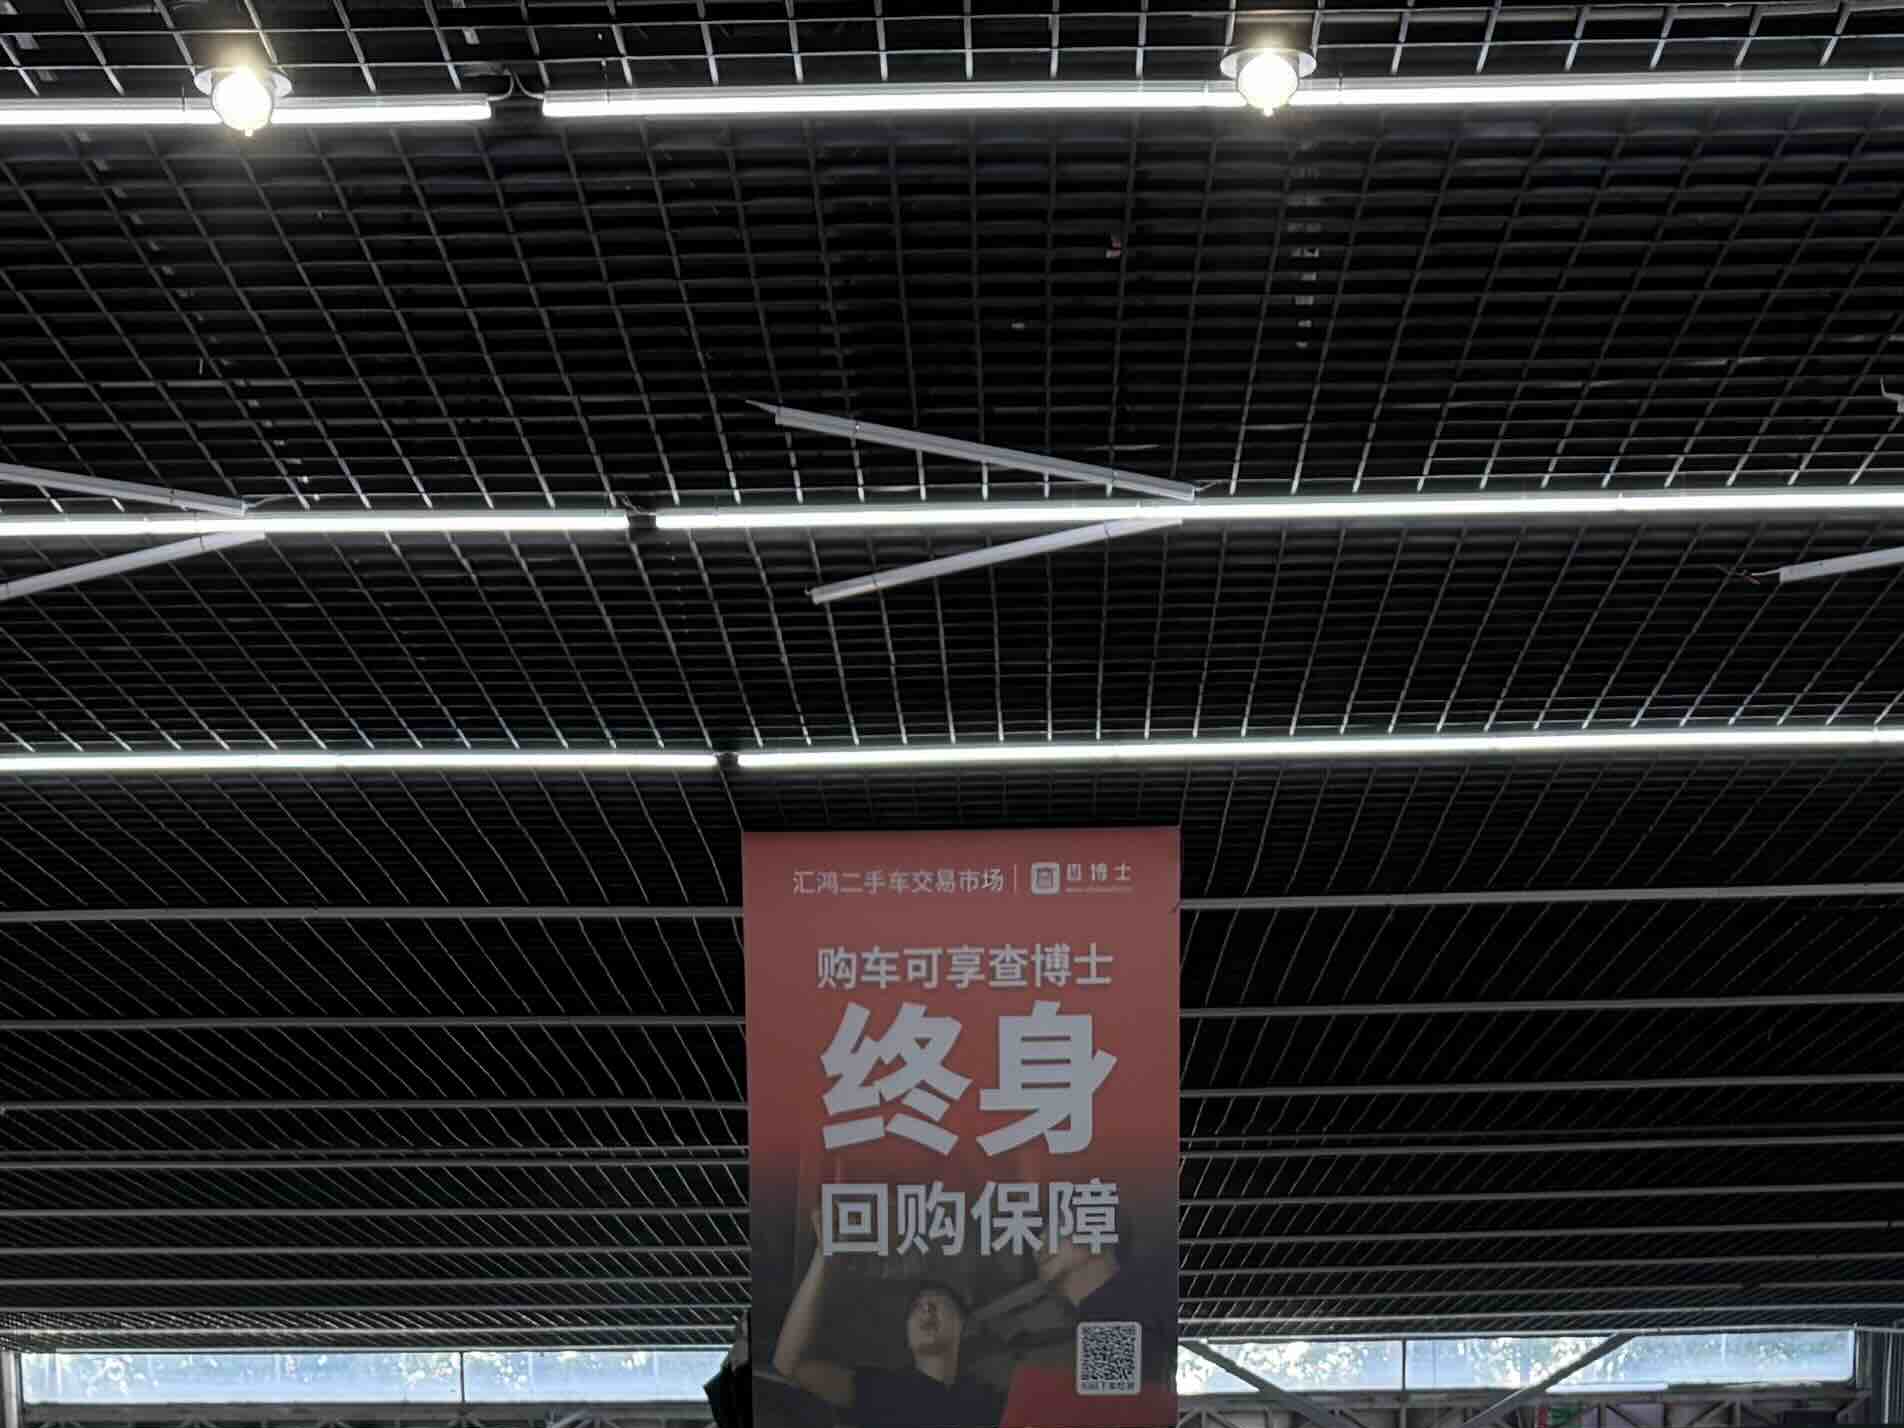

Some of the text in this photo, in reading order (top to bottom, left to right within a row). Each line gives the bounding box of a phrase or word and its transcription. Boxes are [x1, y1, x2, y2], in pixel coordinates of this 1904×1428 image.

[792, 868, 1006, 895] 汇鸿二手车交易市场
[816, 942, 1114, 990] 购车可享查博士
[819, 999, 1118, 1157] 终身
[820, 1178, 1120, 1258] 回购保障
